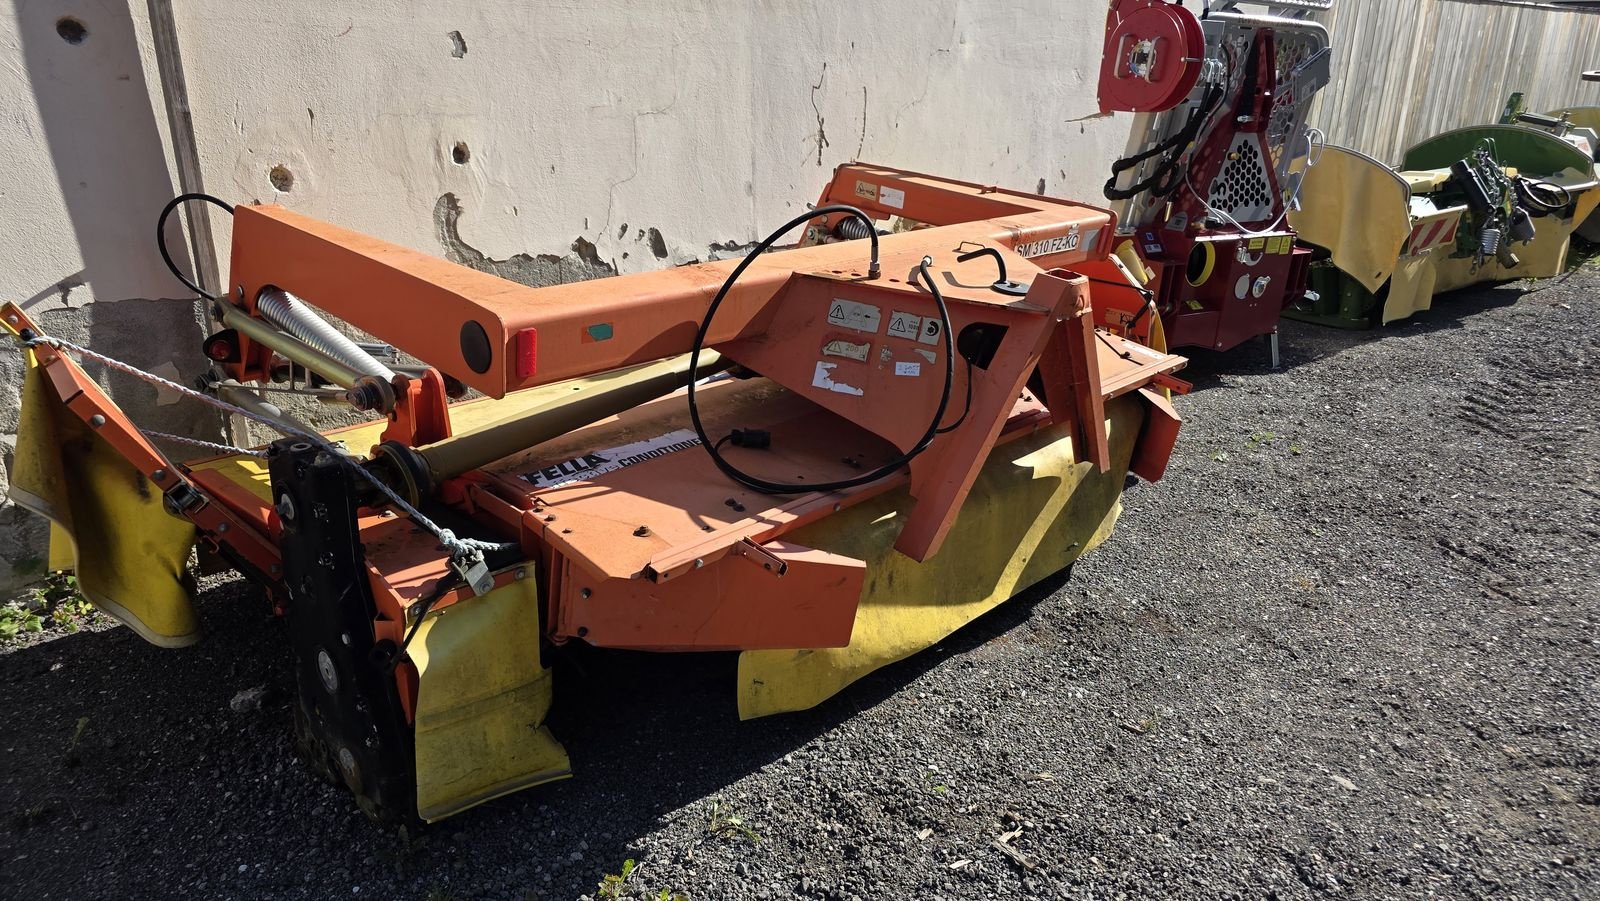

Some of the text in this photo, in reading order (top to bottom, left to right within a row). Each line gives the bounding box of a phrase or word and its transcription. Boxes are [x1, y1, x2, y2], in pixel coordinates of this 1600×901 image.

[1017, 243, 1032, 256] SM
[1033, 239, 1050, 255] 310
[524, 453, 611, 485] FELLA
